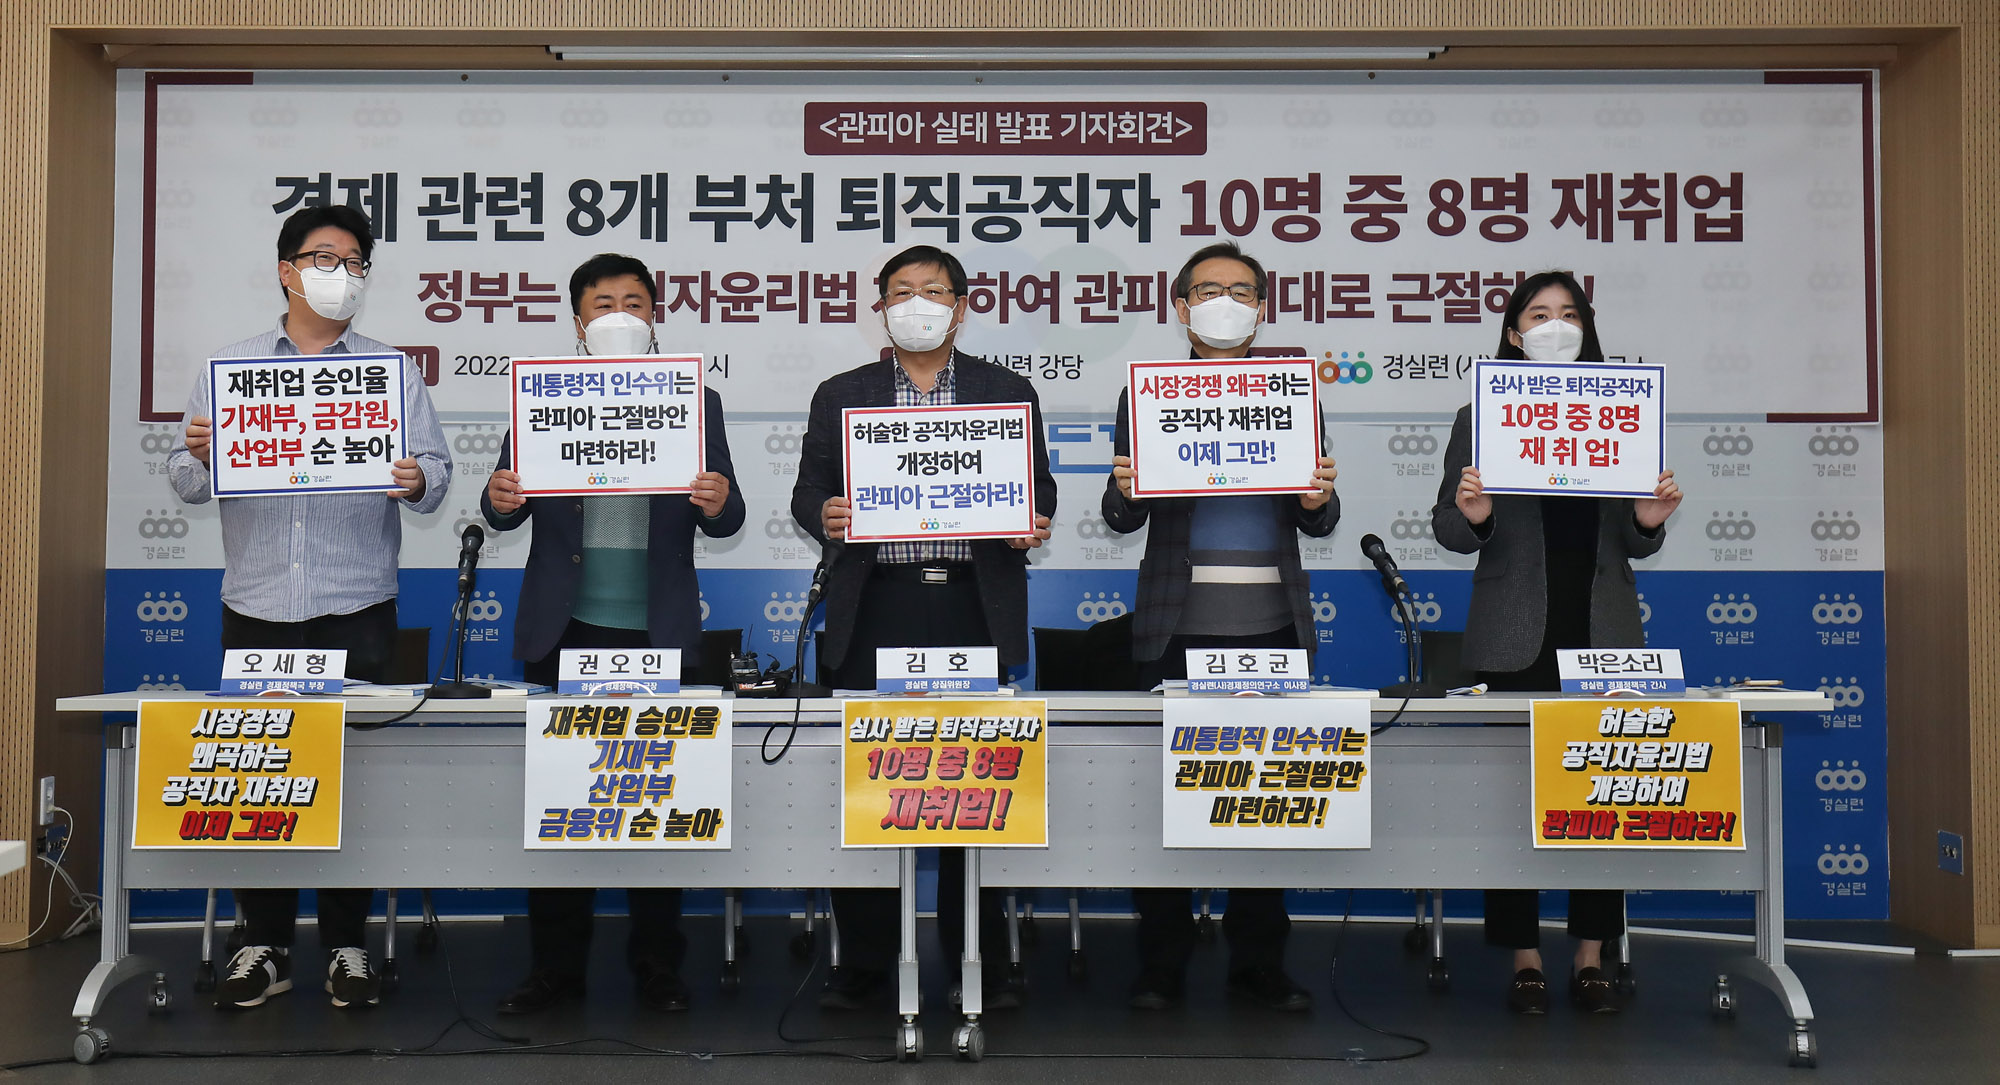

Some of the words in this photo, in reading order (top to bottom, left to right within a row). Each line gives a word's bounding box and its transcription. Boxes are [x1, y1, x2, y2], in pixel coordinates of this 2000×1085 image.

[820, 112, 925, 144] <관피아
[932, 112, 987, 144] 실태
[996, 111, 1052, 144] 발표
[1061, 111, 1192, 144] 기자회견>
[418, 172, 544, 242] 관련
[566, 172, 668, 242] 8개
[689, 172, 814, 243] 부처
[837, 172, 1160, 243] 퇴직공직자
[1180, 172, 1321, 242] 10명
[1343, 174, 1408, 242] 중
[1427, 172, 1528, 242] 8명
[1551, 172, 1744, 243] 재취업
[418, 270, 561, 324] 정부는
[1039, 355, 1084, 380] 강당
[1383, 354, 1449, 379] 경실련
[228, 368, 304, 398] 재취업
[312, 366, 388, 395] 승인율
[522, 372, 605, 397] 대통령직
[611, 371, 695, 395] 인수위는
[1140, 374, 1222, 399] 시장경쟁
[1227, 372, 1310, 398] 왜곡하는
[1489, 374, 1524, 395] 심사
[1528, 375, 1563, 395] 받은
[1566, 376, 1653, 398] 퇴직공직자
[221, 403, 306, 435] 기재부,
[312, 400, 398, 432] 금감원,
[529, 406, 596, 432] 관피아
[600, 404, 688, 430] 근절방안
[854, 422, 910, 443] 허술한
[913, 418, 1024, 442] 공직자윤리법
[1159, 407, 1224, 433] 공직자
[1228, 405, 1292, 431] 재취업
[1500, 402, 1558, 431] 10명
[1565, 403, 1592, 431] 중
[1598, 404, 1640, 433] 8명
[227, 438, 305, 468] 산업부
[311, 437, 336, 464] 순
[343, 434, 394, 464] 높아
[561, 439, 656, 465] 마련하라!
[897, 450, 982, 476] 개정하여
[1178, 440, 1220, 466] 이제
[1226, 440, 1276, 465] 그만!
[1392, 463, 1435, 476] 경실련
[1707, 463, 1750, 477] 경실련
[1812, 463, 1856, 477] 경실련
[856, 484, 923, 511] 관피아
[927, 481, 1024, 509] 근절하라!
[142, 546, 185, 559] 경실련
[768, 547, 810, 560] 경실련
[1080, 548, 1124, 560] 경실련
[1395, 548, 1437, 560] 경실련
[1710, 548, 1753, 561] 경실련
[1815, 548, 1858, 561] 경실련
[140, 629, 184, 643] 경실련
[1711, 630, 1754, 645] 경실련
[1816, 630, 1860, 645] 경실련
[1578, 653, 1663, 674] 박은소리
[240, 681, 262, 690] 경실련
[266, 681, 305, 690] 경제정책국
[308, 681, 324, 690] 부장
[905, 681, 927, 689] 경실련
[1284, 681, 1307, 690] 이사장
[1580, 681, 1603, 689] 경실련
[1608, 681, 1647, 689] 경제정책국
[1651, 681, 1667, 689] 간사
[191, 708, 295, 738] 시장경쟁
[543, 705, 632, 738] 재취업
[635, 706, 722, 739] 승인율
[850, 716, 892, 742] 심사
[894, 716, 937, 742] 받은
[938, 716, 1042, 742] 퇴직공직자
[1598, 706, 1675, 737] 허술한
[1818, 714, 1862, 728] 경실련
[1170, 726, 1268, 755] 대통령직
[1272, 726, 1368, 754] 인수위는
[189, 742, 291, 772] 왜곡하는
[589, 740, 677, 772] 기재부
[867, 747, 933, 780] 10명
[936, 747, 967, 780] 중
[972, 747, 1024, 780] 8명
[1562, 741, 1713, 772] 공직자윤리법
[1175, 760, 1256, 791] 관피아
[1259, 760, 1366, 791] 근절방안
[161, 776, 239, 805] 공직자
[240, 776, 318, 806] 재취업
[588, 774, 676, 806] 산업부
[1586, 775, 1688, 806] 개정하여
[881, 786, 1012, 831] 재취업!
[1210, 796, 1330, 828] 마련하라!
[1820, 798, 1864, 812] 경실련
[179, 810, 232, 840] 이제
[233, 811, 298, 841] 그만!
[538, 808, 627, 841] 금융위
[629, 808, 660, 840] 순
[664, 808, 724, 840] 높아
[1542, 810, 1618, 840] 관피아
[1623, 810, 1736, 841] 근절하라!
[1822, 882, 1866, 896] 경실련
